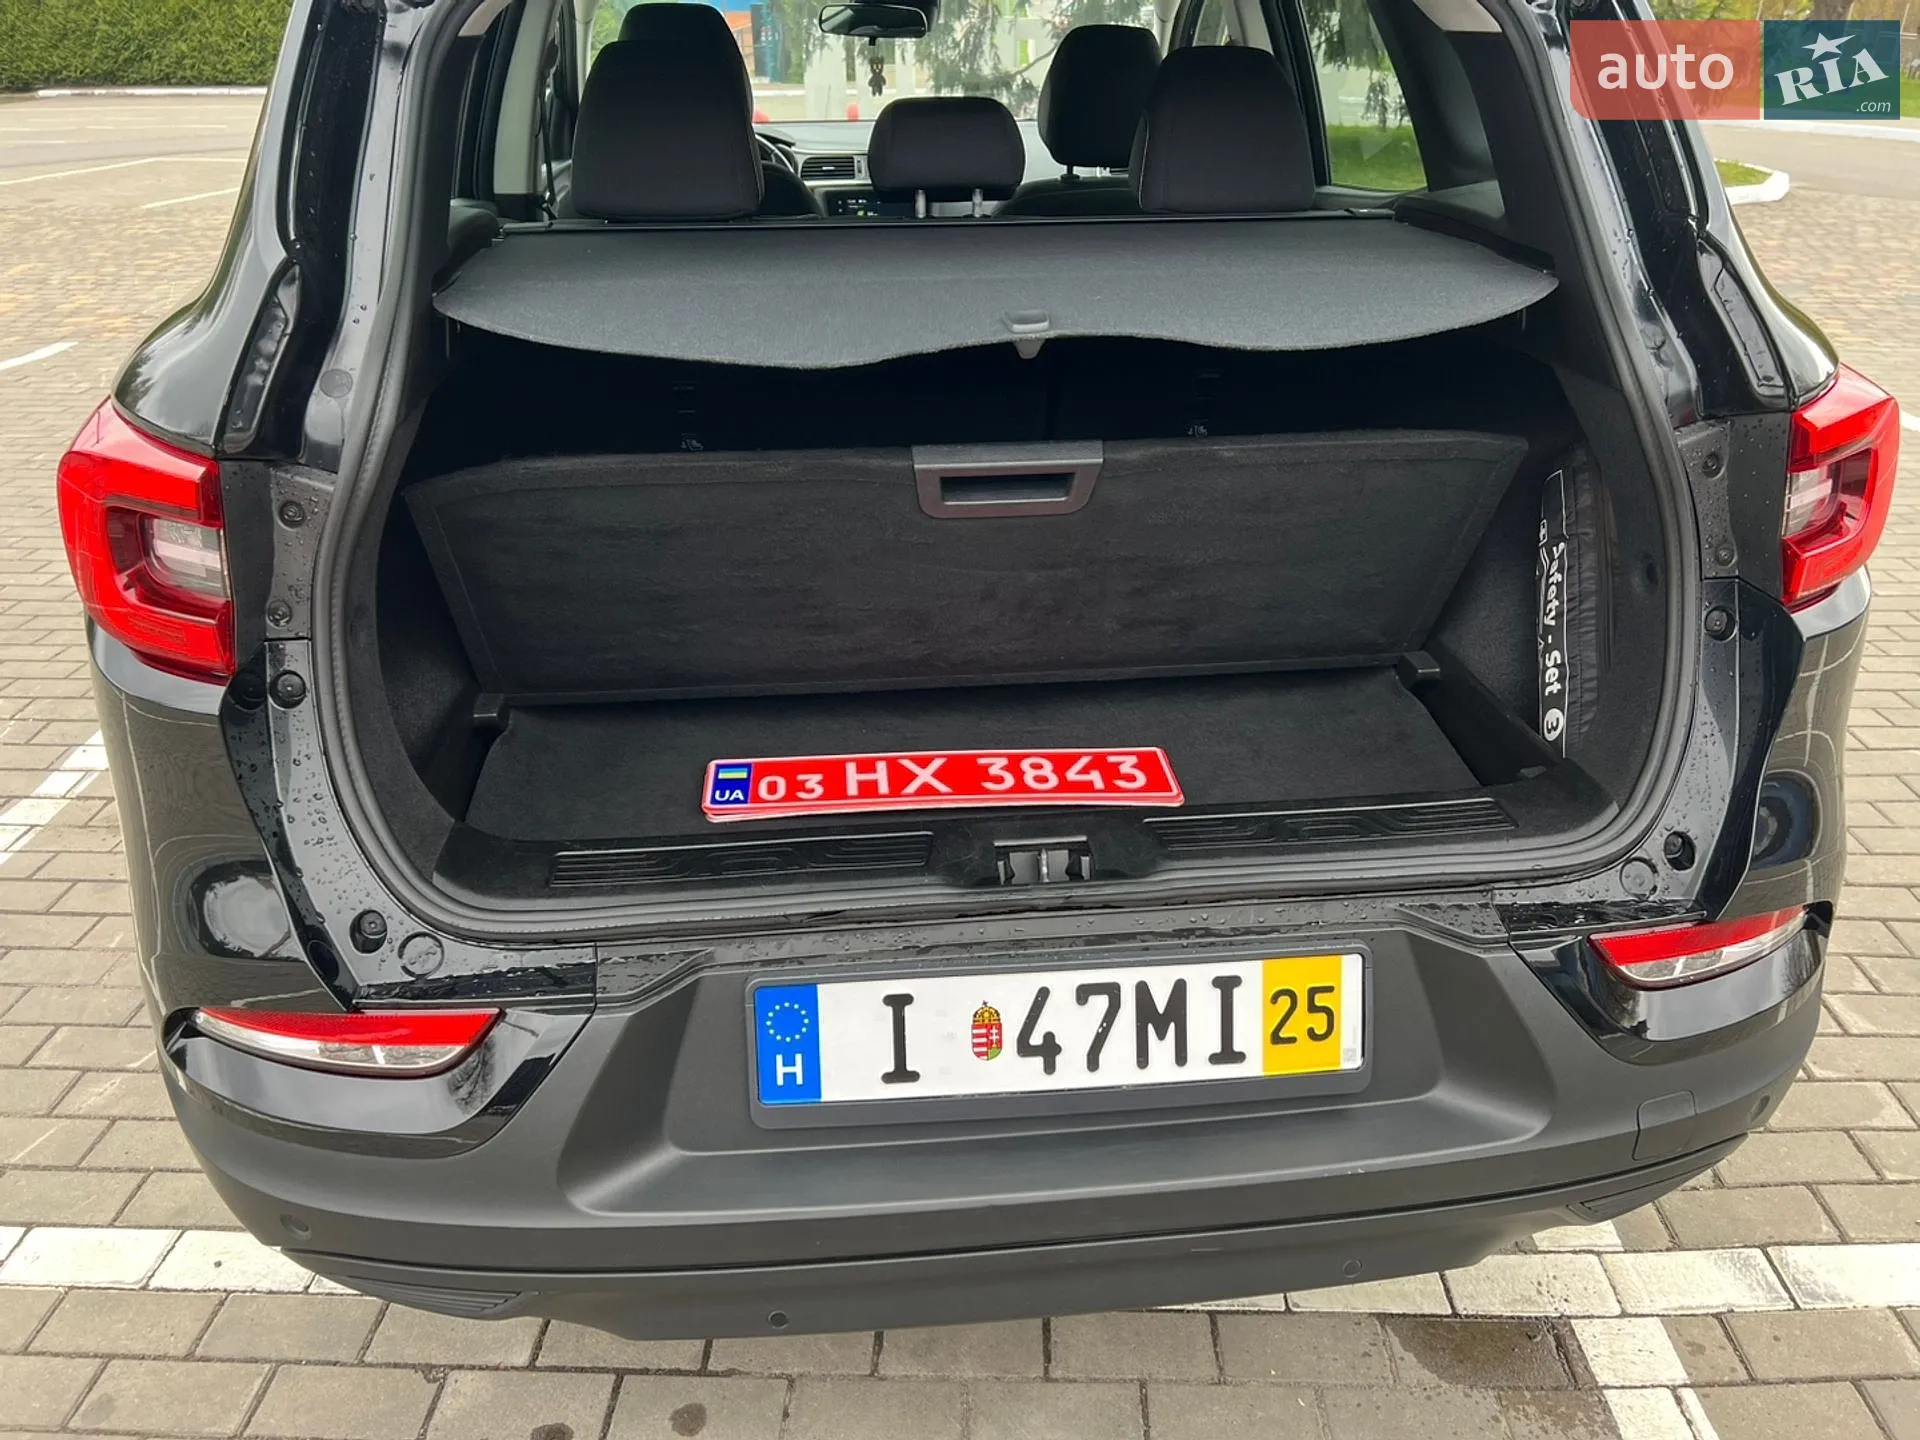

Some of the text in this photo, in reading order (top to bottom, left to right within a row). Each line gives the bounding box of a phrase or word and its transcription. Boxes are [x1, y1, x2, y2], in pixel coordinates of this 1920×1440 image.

[1544, 542, 1565, 626] Safety
[1545, 650, 1562, 696] Set
[714, 754, 1148, 802] UA 03 HX 3843
[775, 975, 1336, 1086] H I 47MI 25
